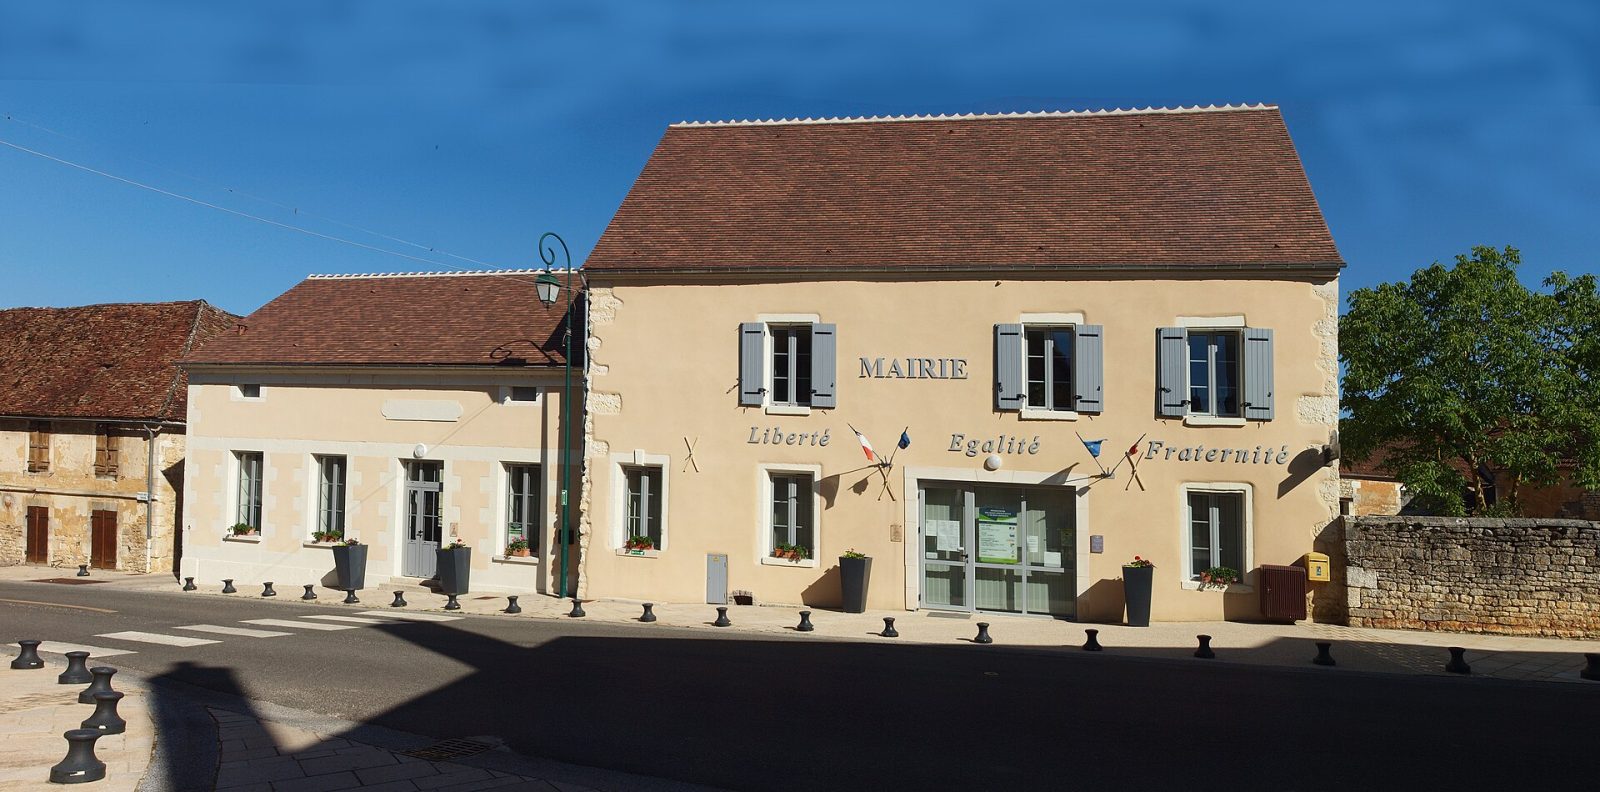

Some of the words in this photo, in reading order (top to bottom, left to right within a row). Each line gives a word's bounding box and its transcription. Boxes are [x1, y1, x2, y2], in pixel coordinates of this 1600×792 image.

[858, 357, 969, 380] MAIRIE
[747, 426, 831, 447] Liberté
[947, 433, 1041, 458] Egalité
[1144, 440, 1290, 466] Fraternité
